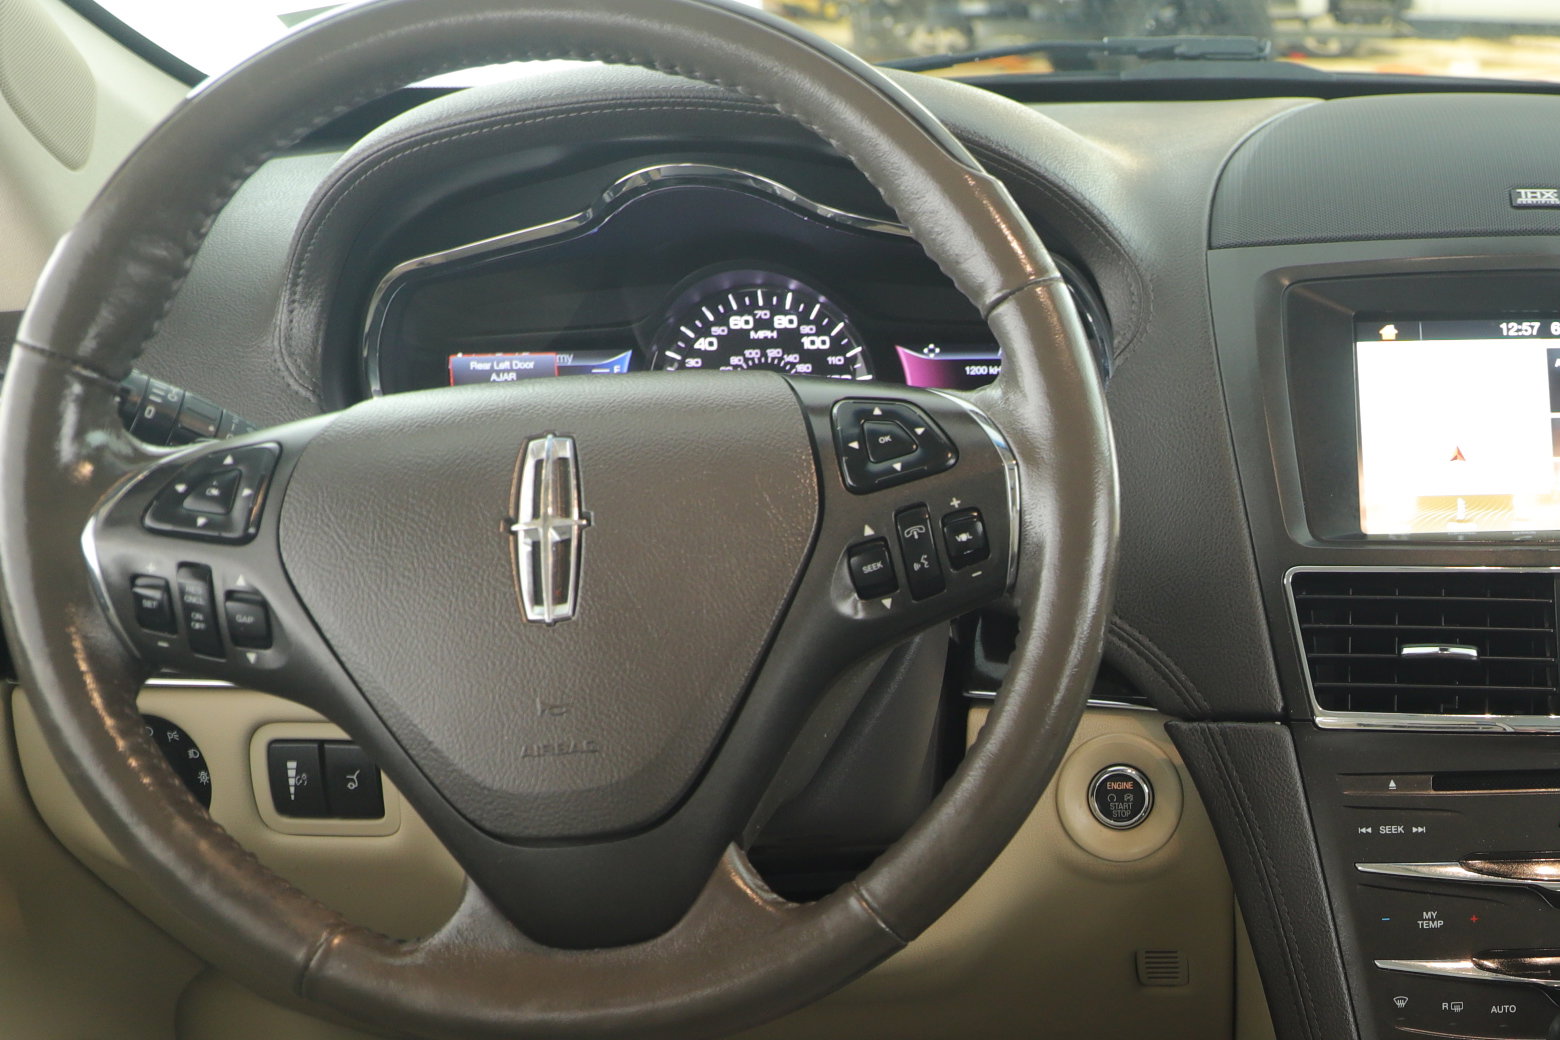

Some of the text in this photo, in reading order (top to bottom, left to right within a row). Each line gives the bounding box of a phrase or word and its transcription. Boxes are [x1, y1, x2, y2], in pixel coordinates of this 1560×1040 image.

[754, 310, 770, 319] 70
[729, 316, 754, 329] 60
[773, 315, 798, 329] 80
[711, 327, 728, 335] 50
[800, 325, 816, 334] 90
[1500, 322, 1541, 335] 12:57
[750, 330, 777, 339] MPH
[693, 337, 718, 350] 40
[801, 336, 830, 349] 100
[685, 358, 702, 367] 30
[827, 355, 844, 364] 110
[470, 360, 535, 370] Rear Left Door
[965, 366, 1002, 375] 1200 kH
[490, 373, 517, 382] AJAR
[878, 434, 892, 444] OK
[862, 561, 884, 573] SEEK
[235, 614, 255, 623] GAP
[1106, 781, 1134, 790] ENGINE
[1110, 802, 1133, 811] START
[1379, 825, 1405, 834] SEEK
[1422, 911, 1438, 919] MY
[1417, 920, 1444, 929] TEMP
[1442, 1002, 1449, 1011] R
[1490, 1004, 1517, 1013] AUTO
